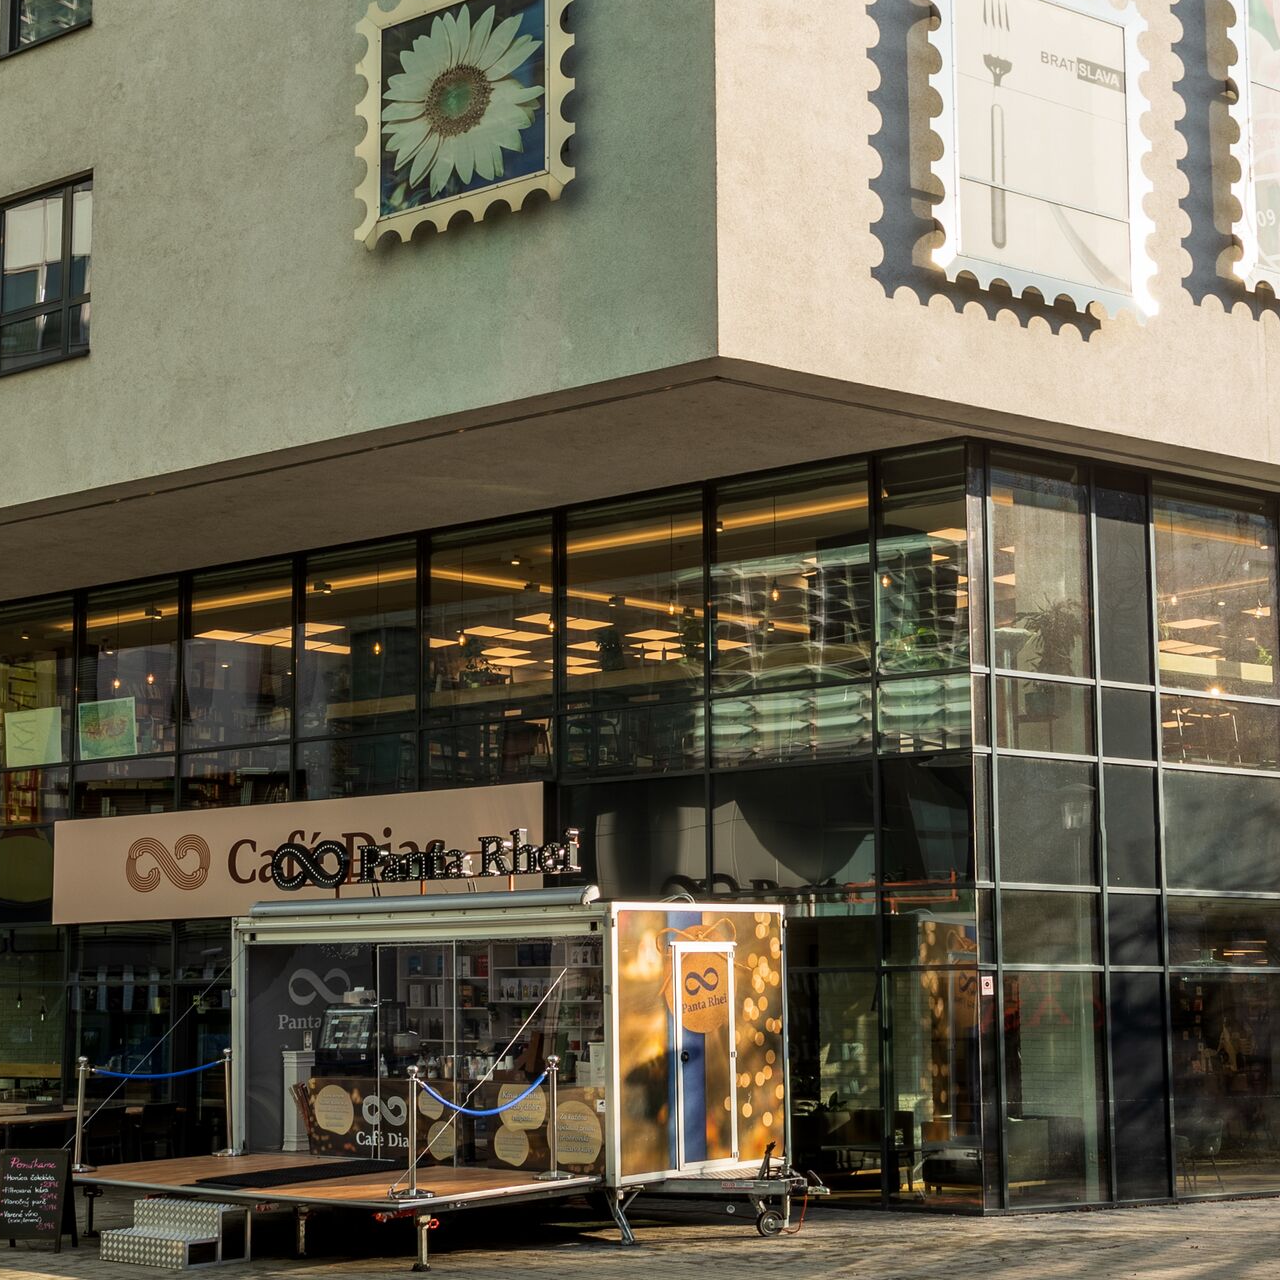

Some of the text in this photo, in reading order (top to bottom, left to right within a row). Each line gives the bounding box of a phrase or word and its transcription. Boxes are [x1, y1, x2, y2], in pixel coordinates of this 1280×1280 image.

[357, 827, 581, 883] Panta Rhei
[682, 992, 727, 1014] Panta Rhei
[277, 1013, 322, 1030] Panta
[356, 1131, 385, 1148] Café
[388, 1131, 410, 1148] Dia
